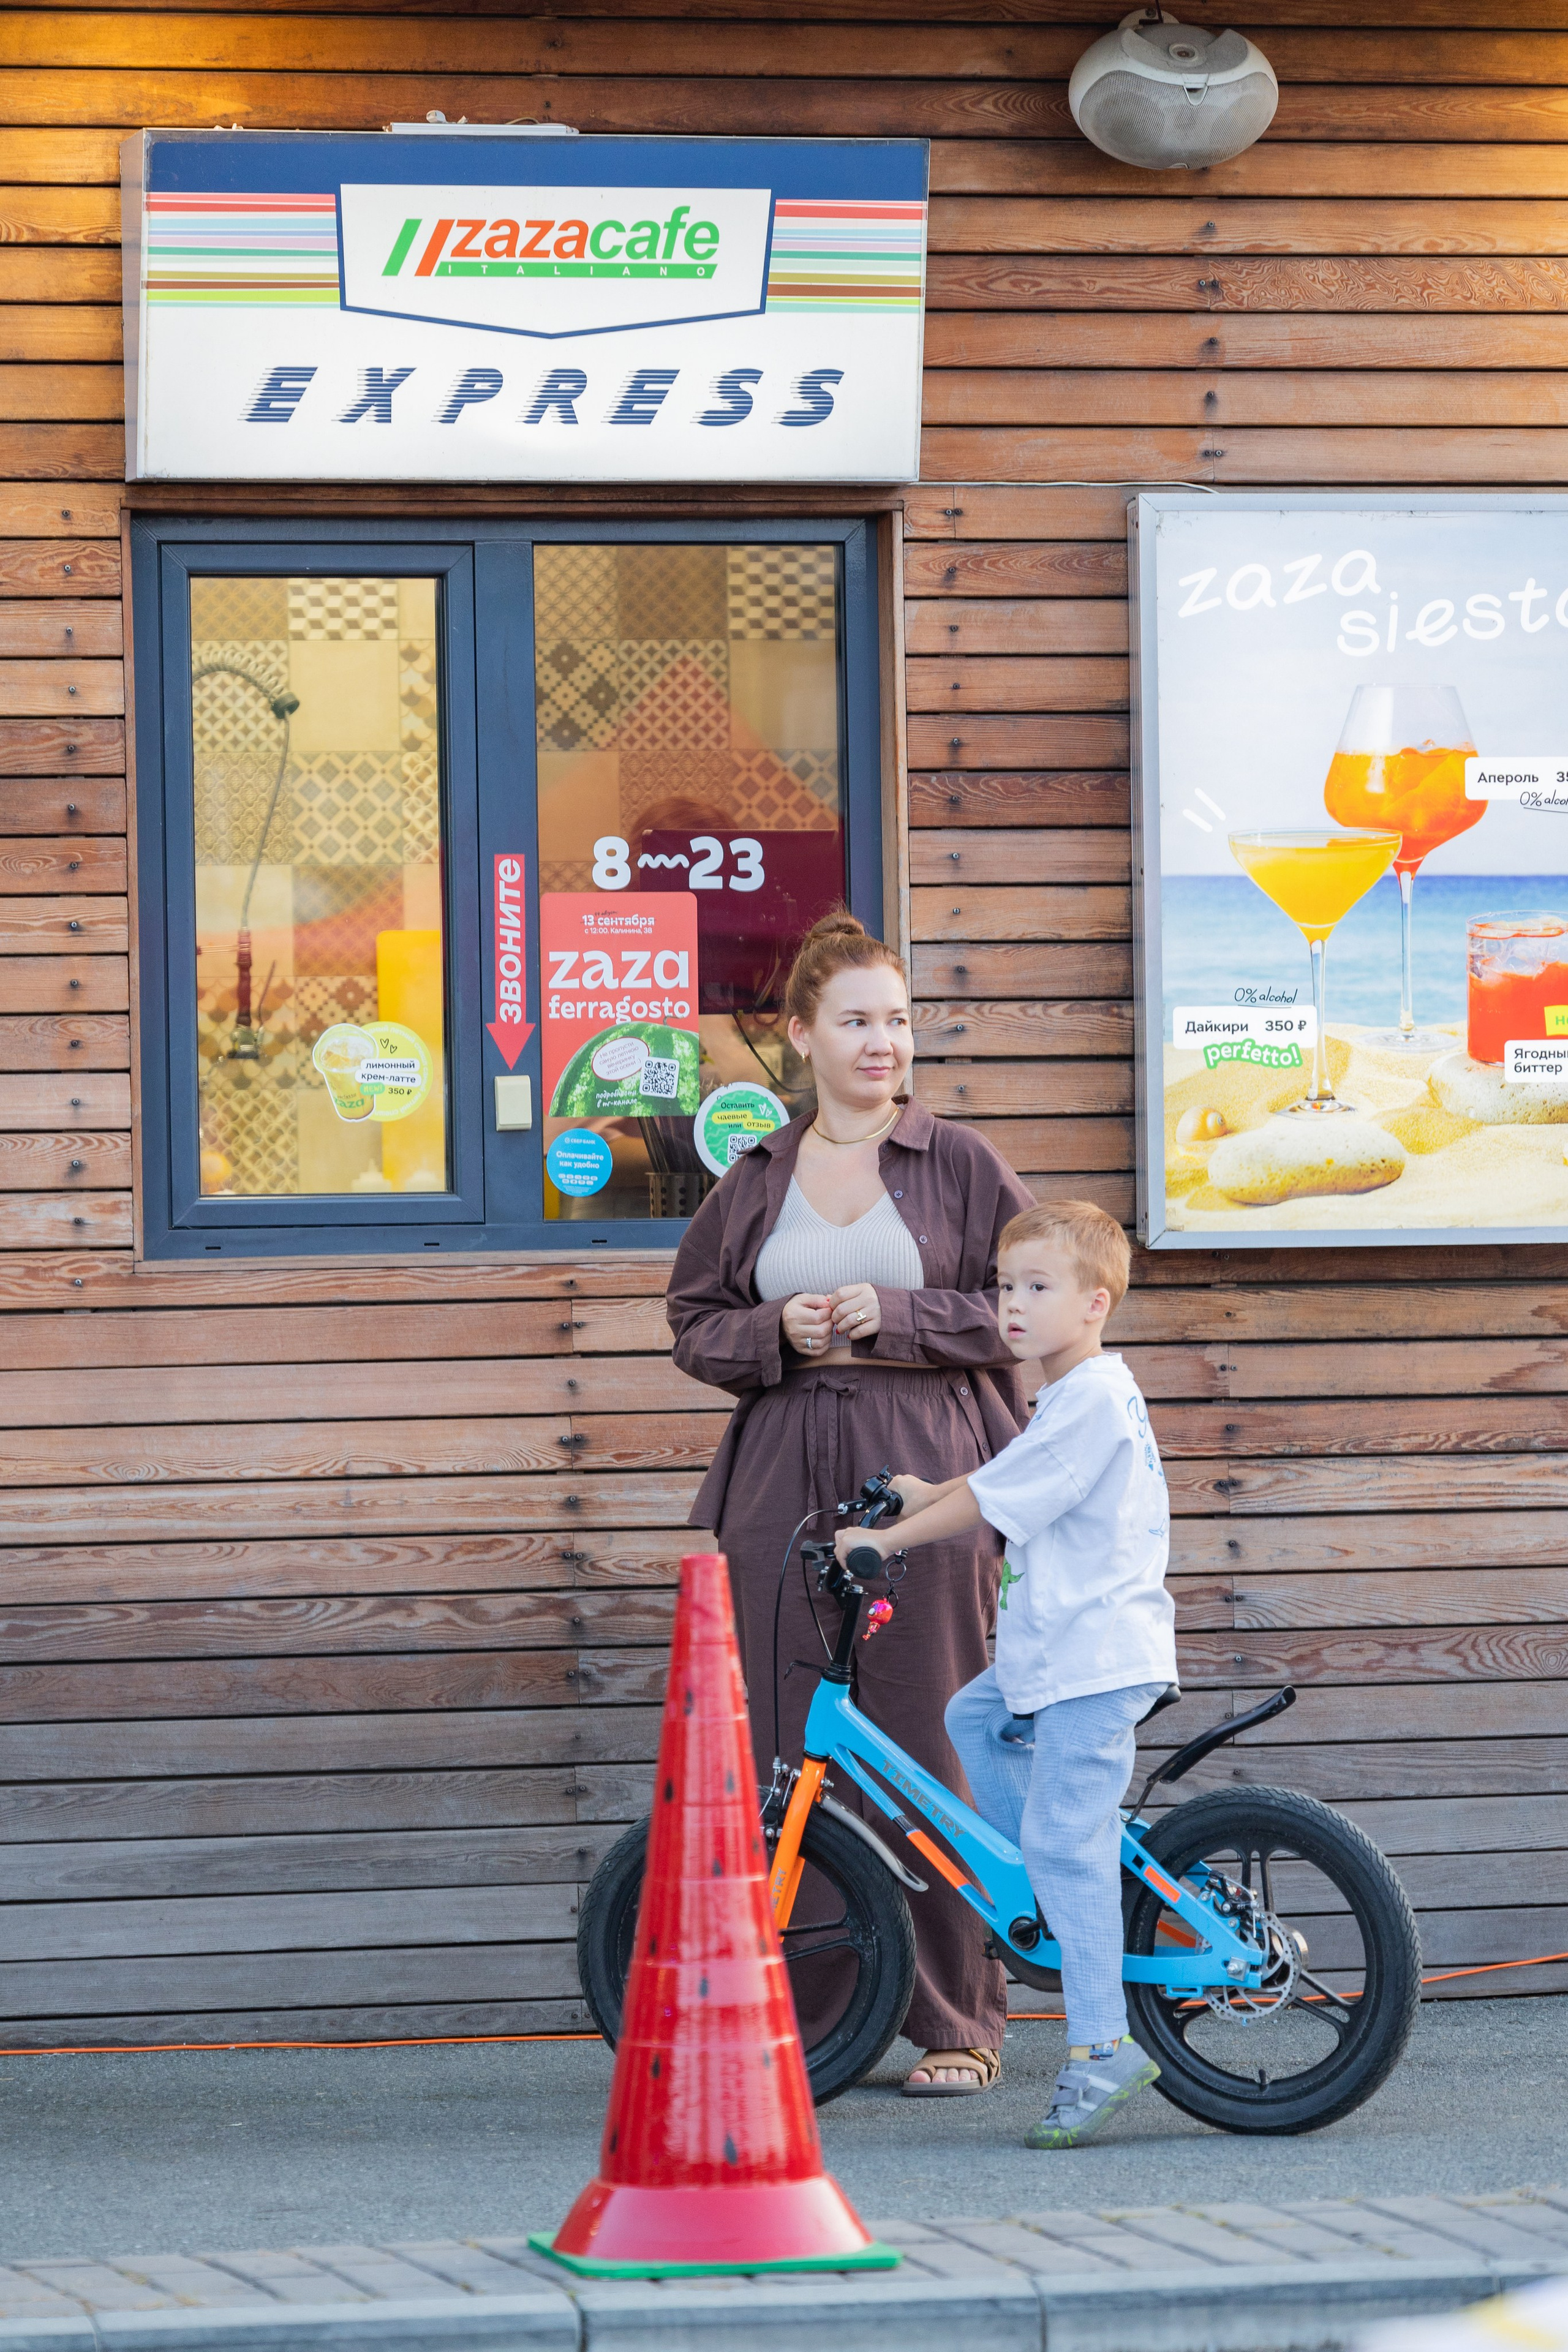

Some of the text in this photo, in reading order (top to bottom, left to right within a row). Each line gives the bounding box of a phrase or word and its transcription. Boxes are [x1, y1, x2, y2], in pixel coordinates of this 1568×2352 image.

[450, 205, 720, 261] zazacafe
[448, 264, 706, 277] ITALIANO
[238, 366, 845, 427] EXPRESS
[1178, 549, 1381, 618] zaza
[1337, 578, 1568, 657] siest
[1477, 772, 1539, 785] Апероль
[582, 913, 655, 928] 13 сентября
[548, 949, 690, 990] zaza
[548, 995, 690, 1025] ferragosto
[1185, 1020, 1249, 1035] Дайкири
[1265, 1020, 1294, 1031] 350
[608, 1041, 634, 1054] пропусти
[1207, 1041, 1300, 1066] perfetto!
[1514, 1048, 1568, 1060] Ягодны
[366, 1060, 415, 1069] лимонный
[1514, 1062, 1562, 1076] биттер
[361, 1072, 417, 1084] крем-латте
[556, 1150, 604, 1161] Оплачивайте
[573, 1161, 600, 1169] удобно
[880, 1758, 966, 1839] TIMETRY
